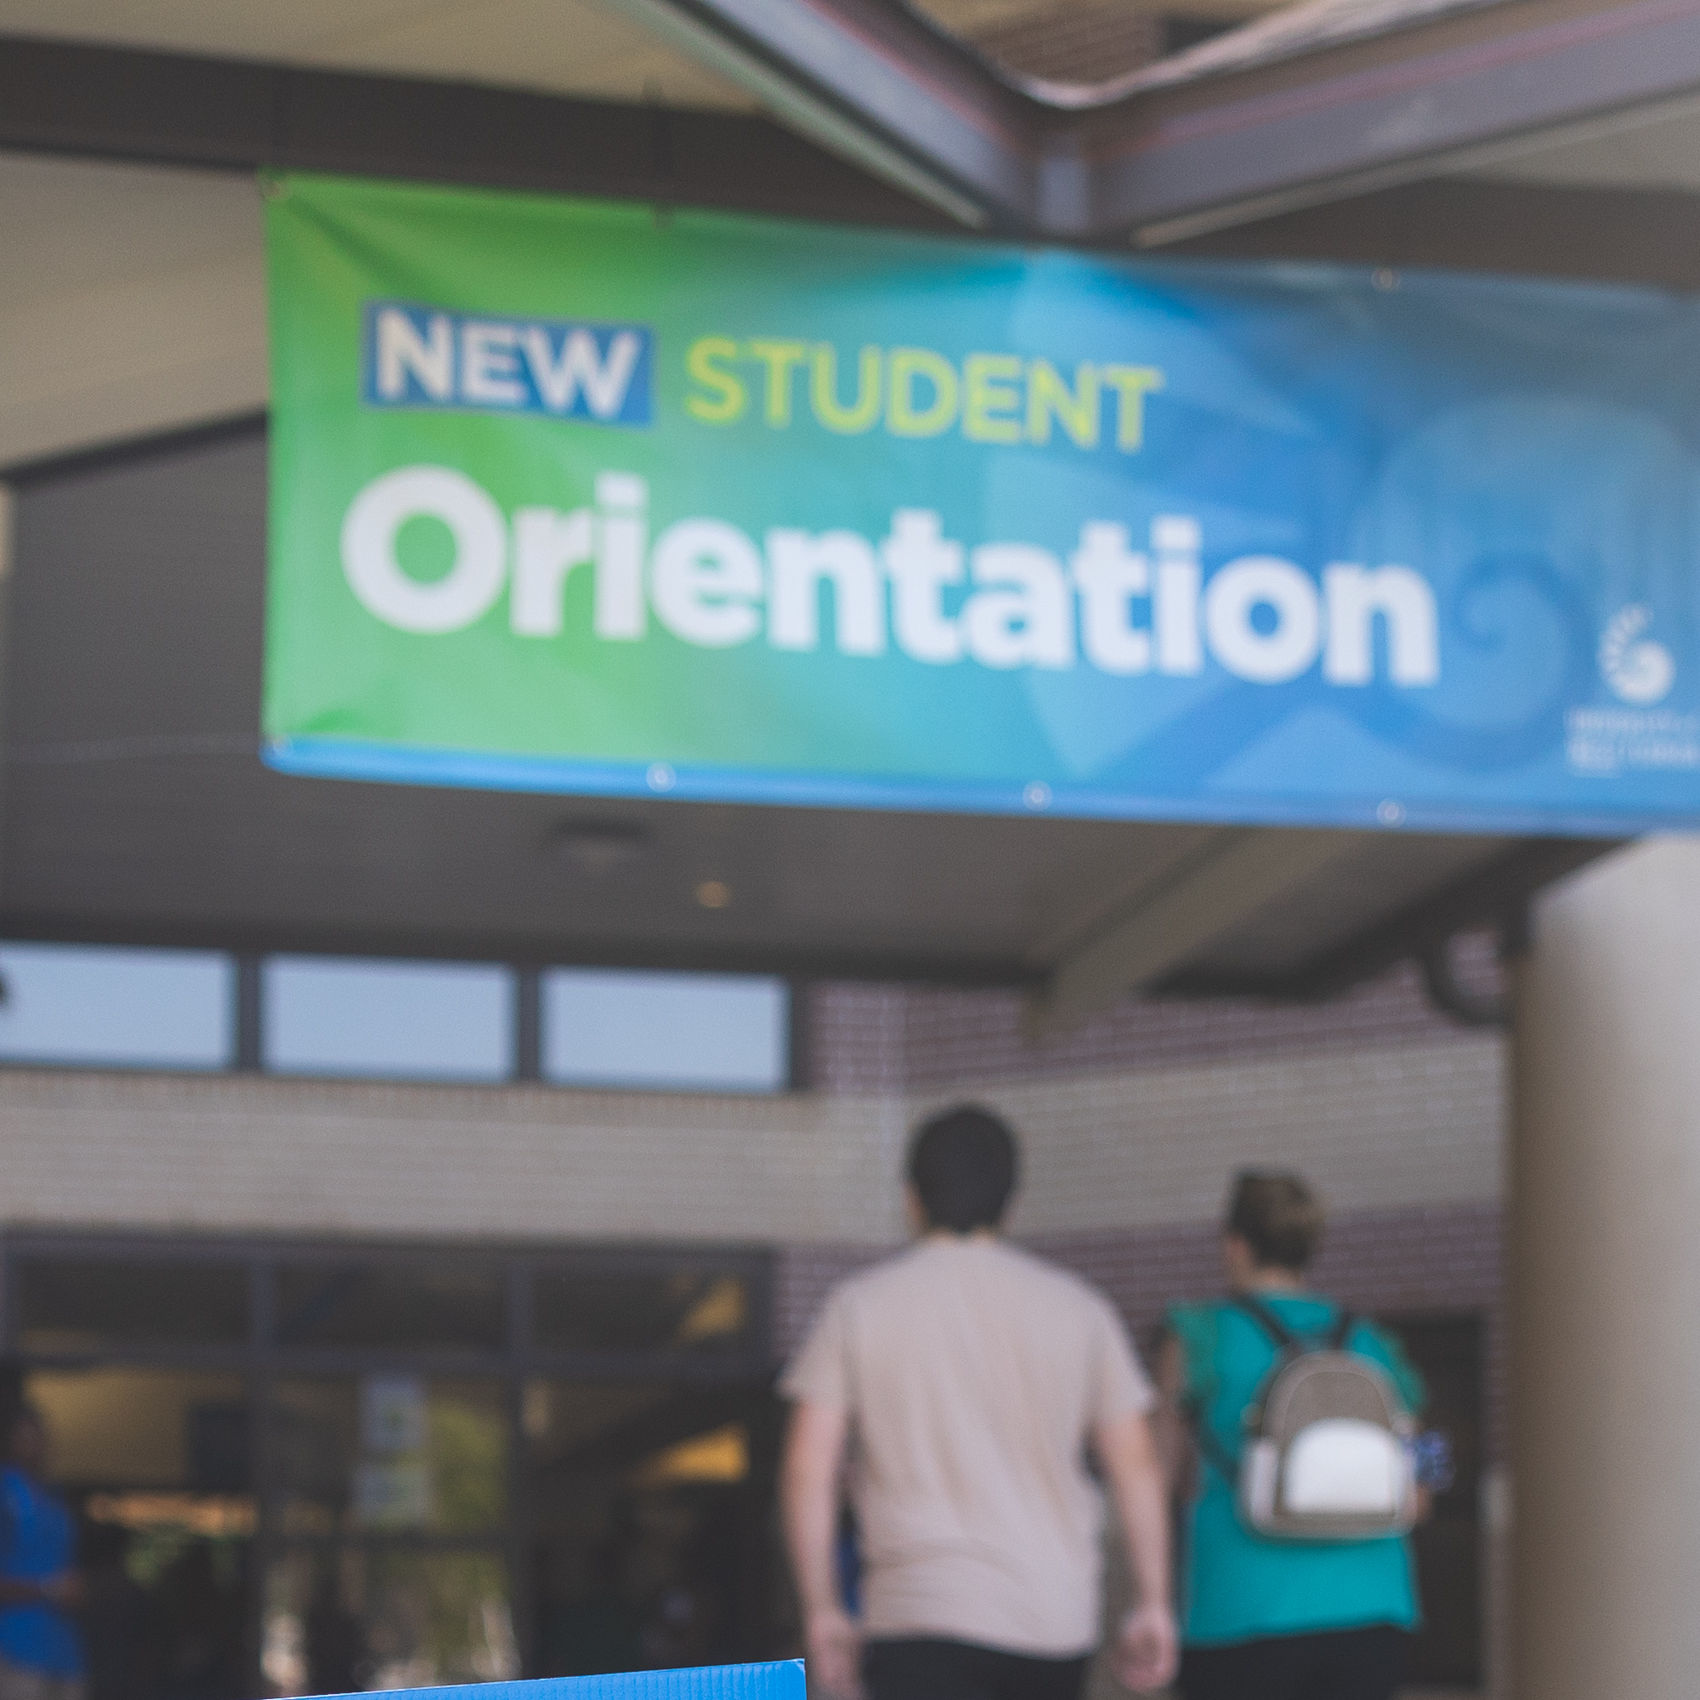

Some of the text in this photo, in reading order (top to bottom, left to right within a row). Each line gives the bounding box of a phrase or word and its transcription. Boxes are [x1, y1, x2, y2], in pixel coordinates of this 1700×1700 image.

[375, 308, 1164, 450] NEW STUDENT
[338, 462, 1440, 686] Orientation
